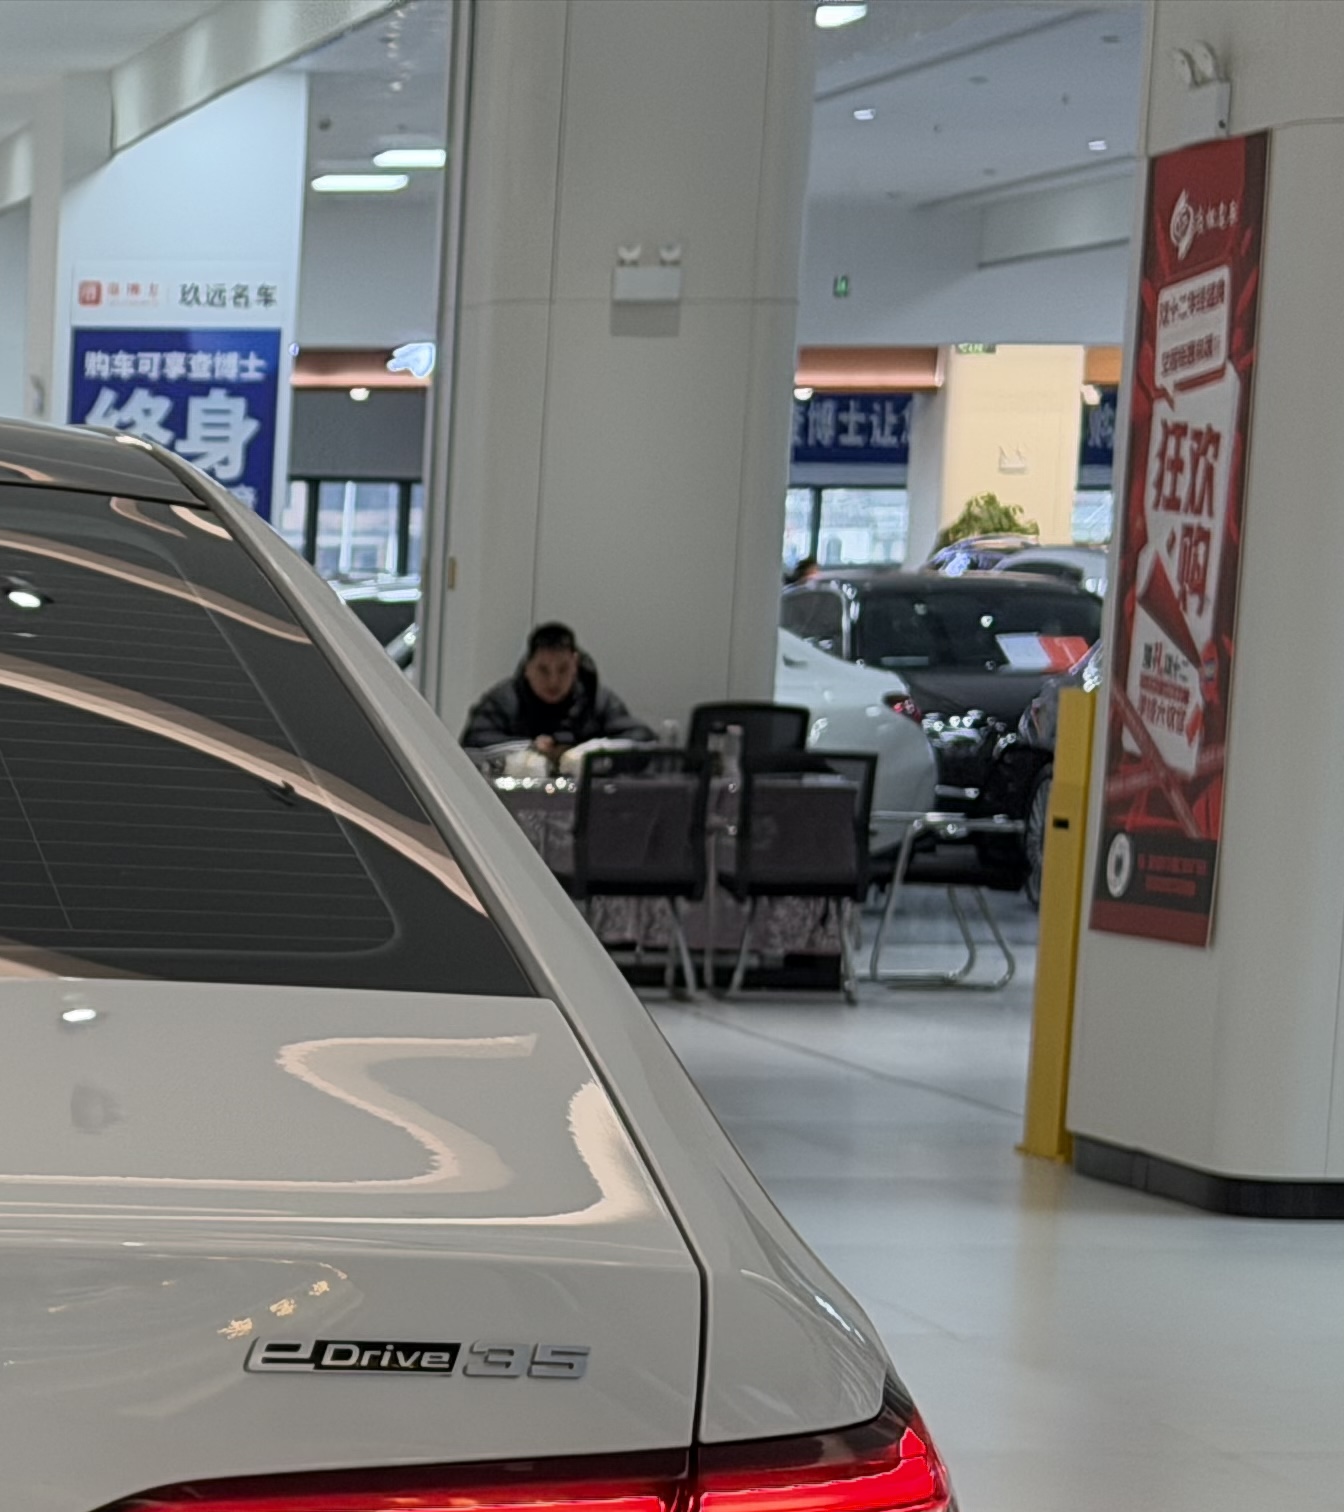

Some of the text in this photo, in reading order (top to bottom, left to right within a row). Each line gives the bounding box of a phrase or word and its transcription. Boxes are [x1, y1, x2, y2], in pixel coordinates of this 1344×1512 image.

[178, 283, 278, 309] 玖远名车
[84, 350, 268, 381] 购车可享查博士
[85, 386, 260, 482] 终身
[1153, 418, 1221, 518] 狂欢
[243, 1336, 592, 1379] eDrive 35
